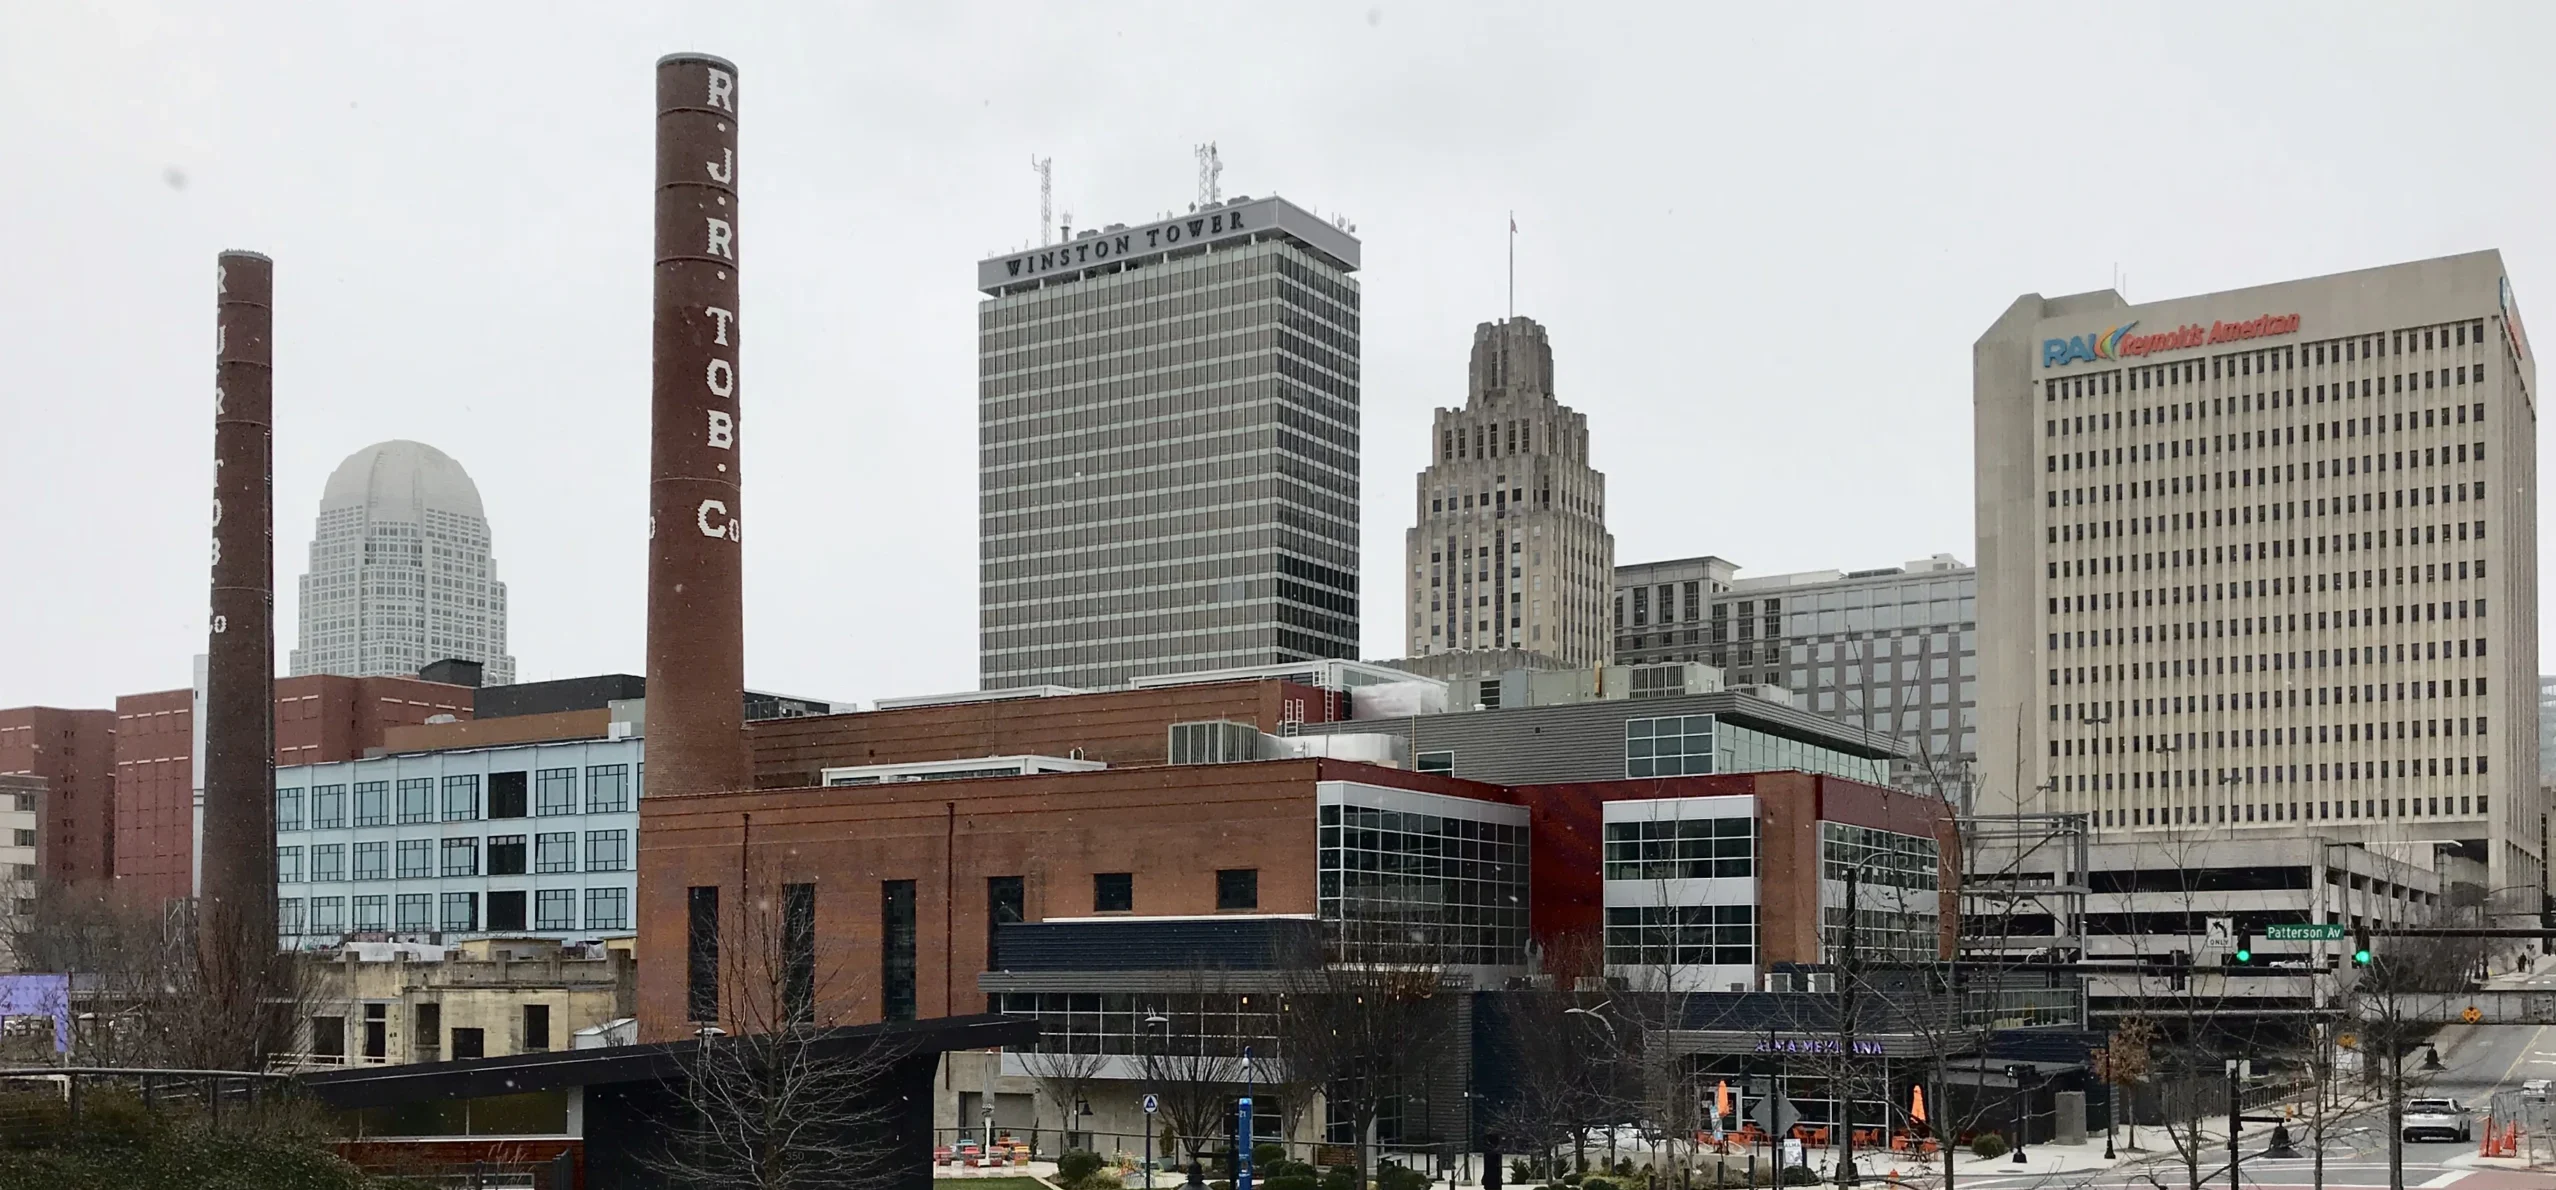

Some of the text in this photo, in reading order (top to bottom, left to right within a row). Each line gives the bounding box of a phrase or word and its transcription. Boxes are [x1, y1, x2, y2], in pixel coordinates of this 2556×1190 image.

[1006, 211, 1244, 277] WINSTON TOWER
[2043, 313, 2300, 368] RAI Reynolds American
[2267, 926, 2341, 939] Patterson Av
[1755, 1039, 1796, 1053] ALMA
[785, 1151, 805, 1161] 350
